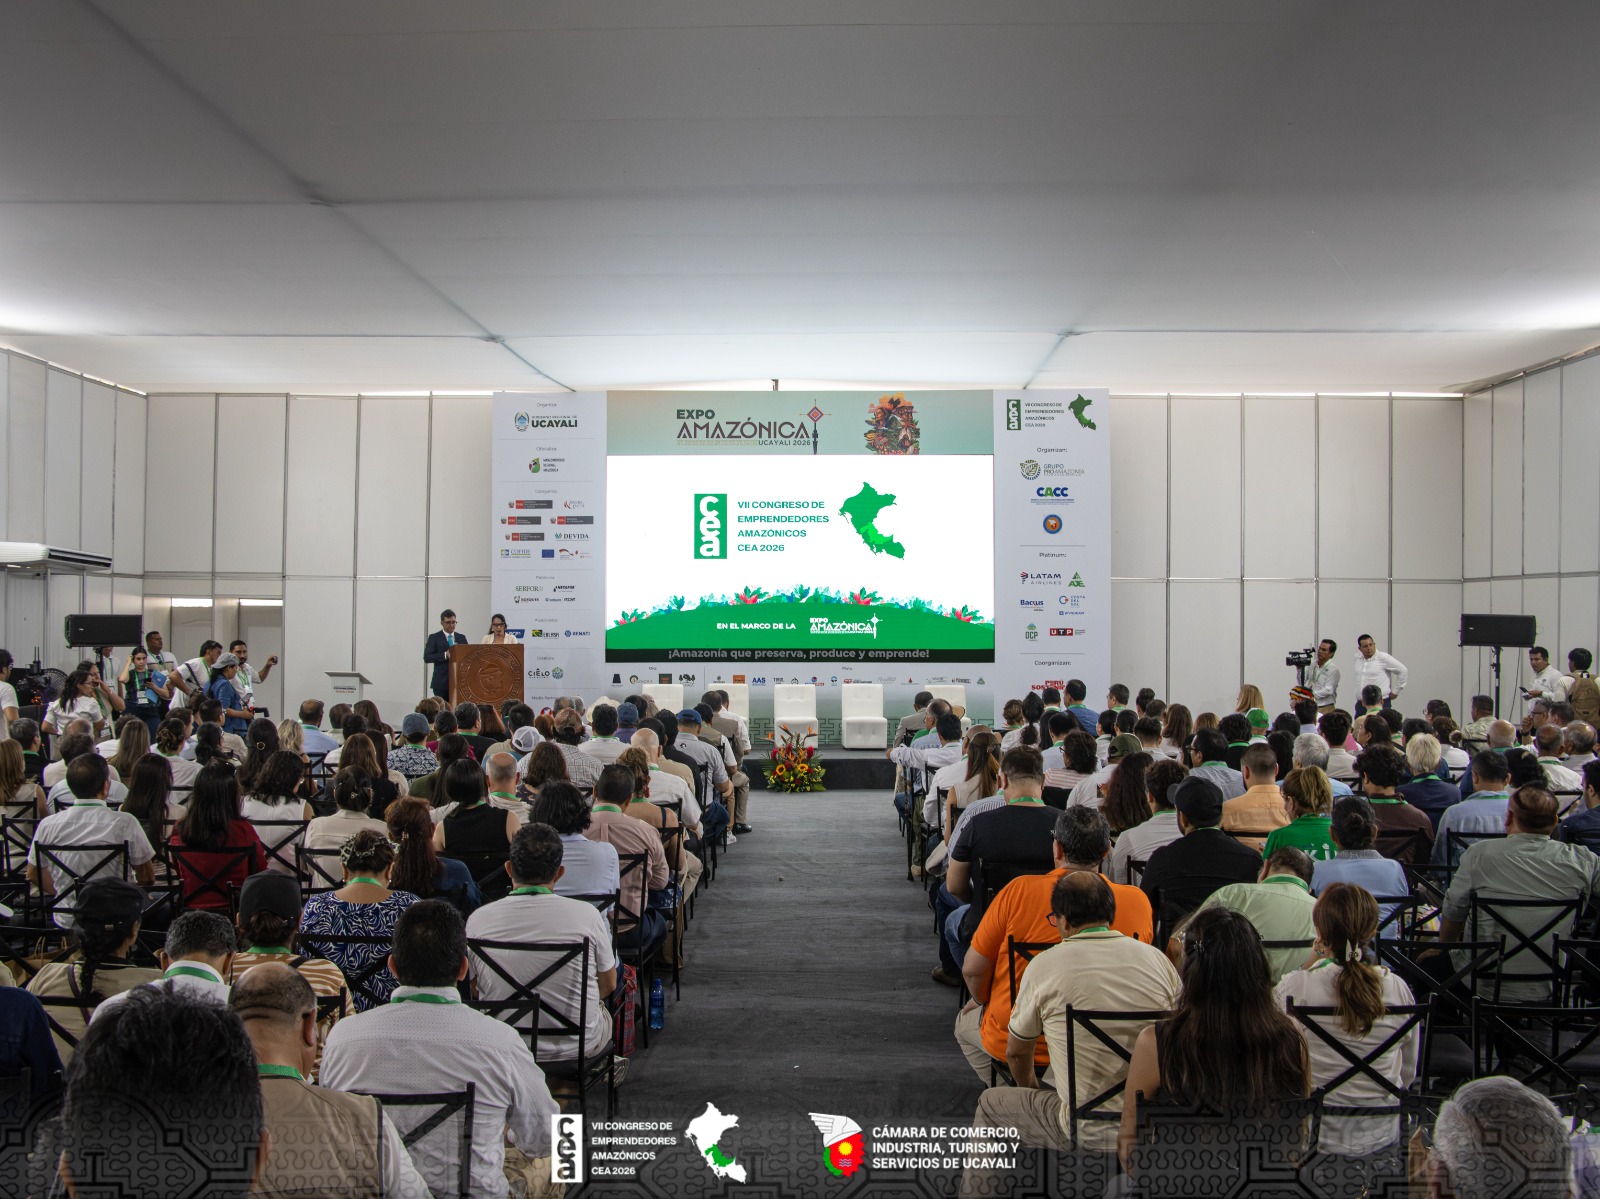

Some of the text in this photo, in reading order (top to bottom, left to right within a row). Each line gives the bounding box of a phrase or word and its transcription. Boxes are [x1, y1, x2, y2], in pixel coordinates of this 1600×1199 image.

[676, 409, 716, 420] EXPO
[532, 420, 578, 428] UCAYALI
[676, 417, 810, 438] AMAZÓNICA
[1036, 487, 1068, 497] CACC
[699, 496, 721, 557] cea
[738, 528, 806, 538] AMAZÓNICOS
[810, 620, 873, 630] AMAZÓNICA
[668, 648, 930, 660] ¡Amazonía que preserva, produce y emprende!
